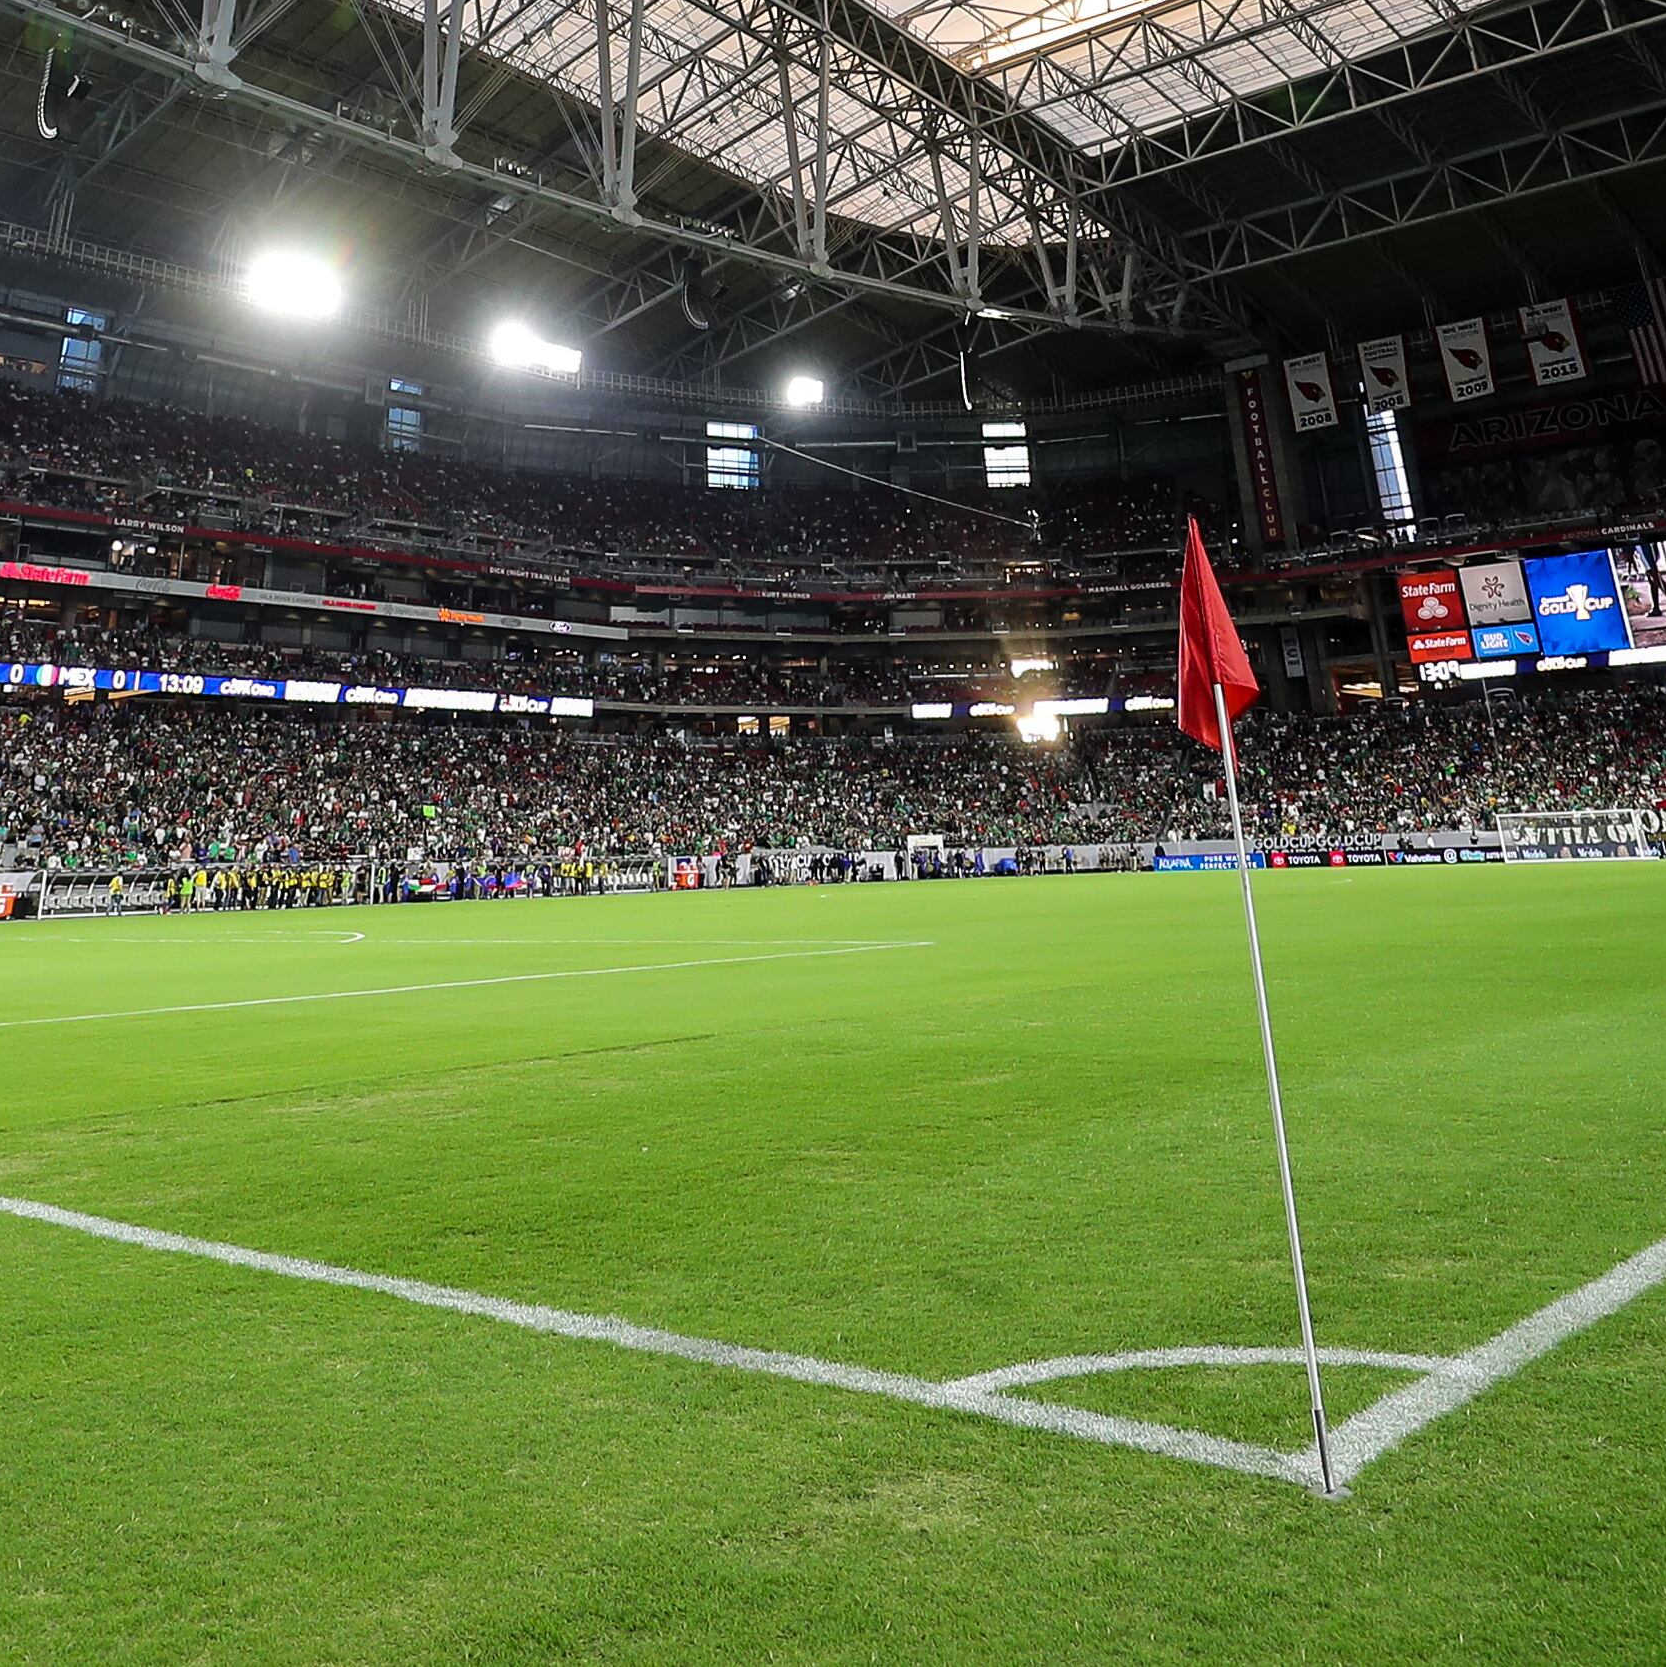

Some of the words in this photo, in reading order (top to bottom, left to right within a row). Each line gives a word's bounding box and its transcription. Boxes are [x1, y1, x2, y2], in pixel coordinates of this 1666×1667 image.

[1542, 305, 1562, 314] WEST
[1458, 322, 1478, 331] WEST
[1541, 363, 1578, 379] 2015
[1457, 380, 1488, 398] 2009
[1374, 395, 1404, 412] 2008
[1300, 412, 1332, 428] 2008
[1246, 387, 1268, 484] FOOTBALL
[1262, 489, 1277, 537] CLUB
[114, 517, 145, 529] LARRY
[147, 521, 184, 534] WILSON
[1601, 522, 1655, 535] CARDINALS
[1088, 585, 1130, 593] MARSHALL
[1469, 600, 1498, 612] Dignity
[1498, 597, 1525, 608] Health
[1539, 600, 1577, 616] GOLD
[1585, 597, 1613, 611] CUP
[1480, 639, 1509, 650] LIGHT
[1482, 633, 1503, 642] BUD
[9, 664, 25, 684] 0
[58, 667, 97, 687] MEX
[112, 671, 126, 690] 0
[159, 674, 204, 695] 13:09
[1288, 855, 1321, 865] TOYOTA
[1347, 853, 1382, 863] TOYOTA
[1404, 853, 1441, 863] Valvoline
